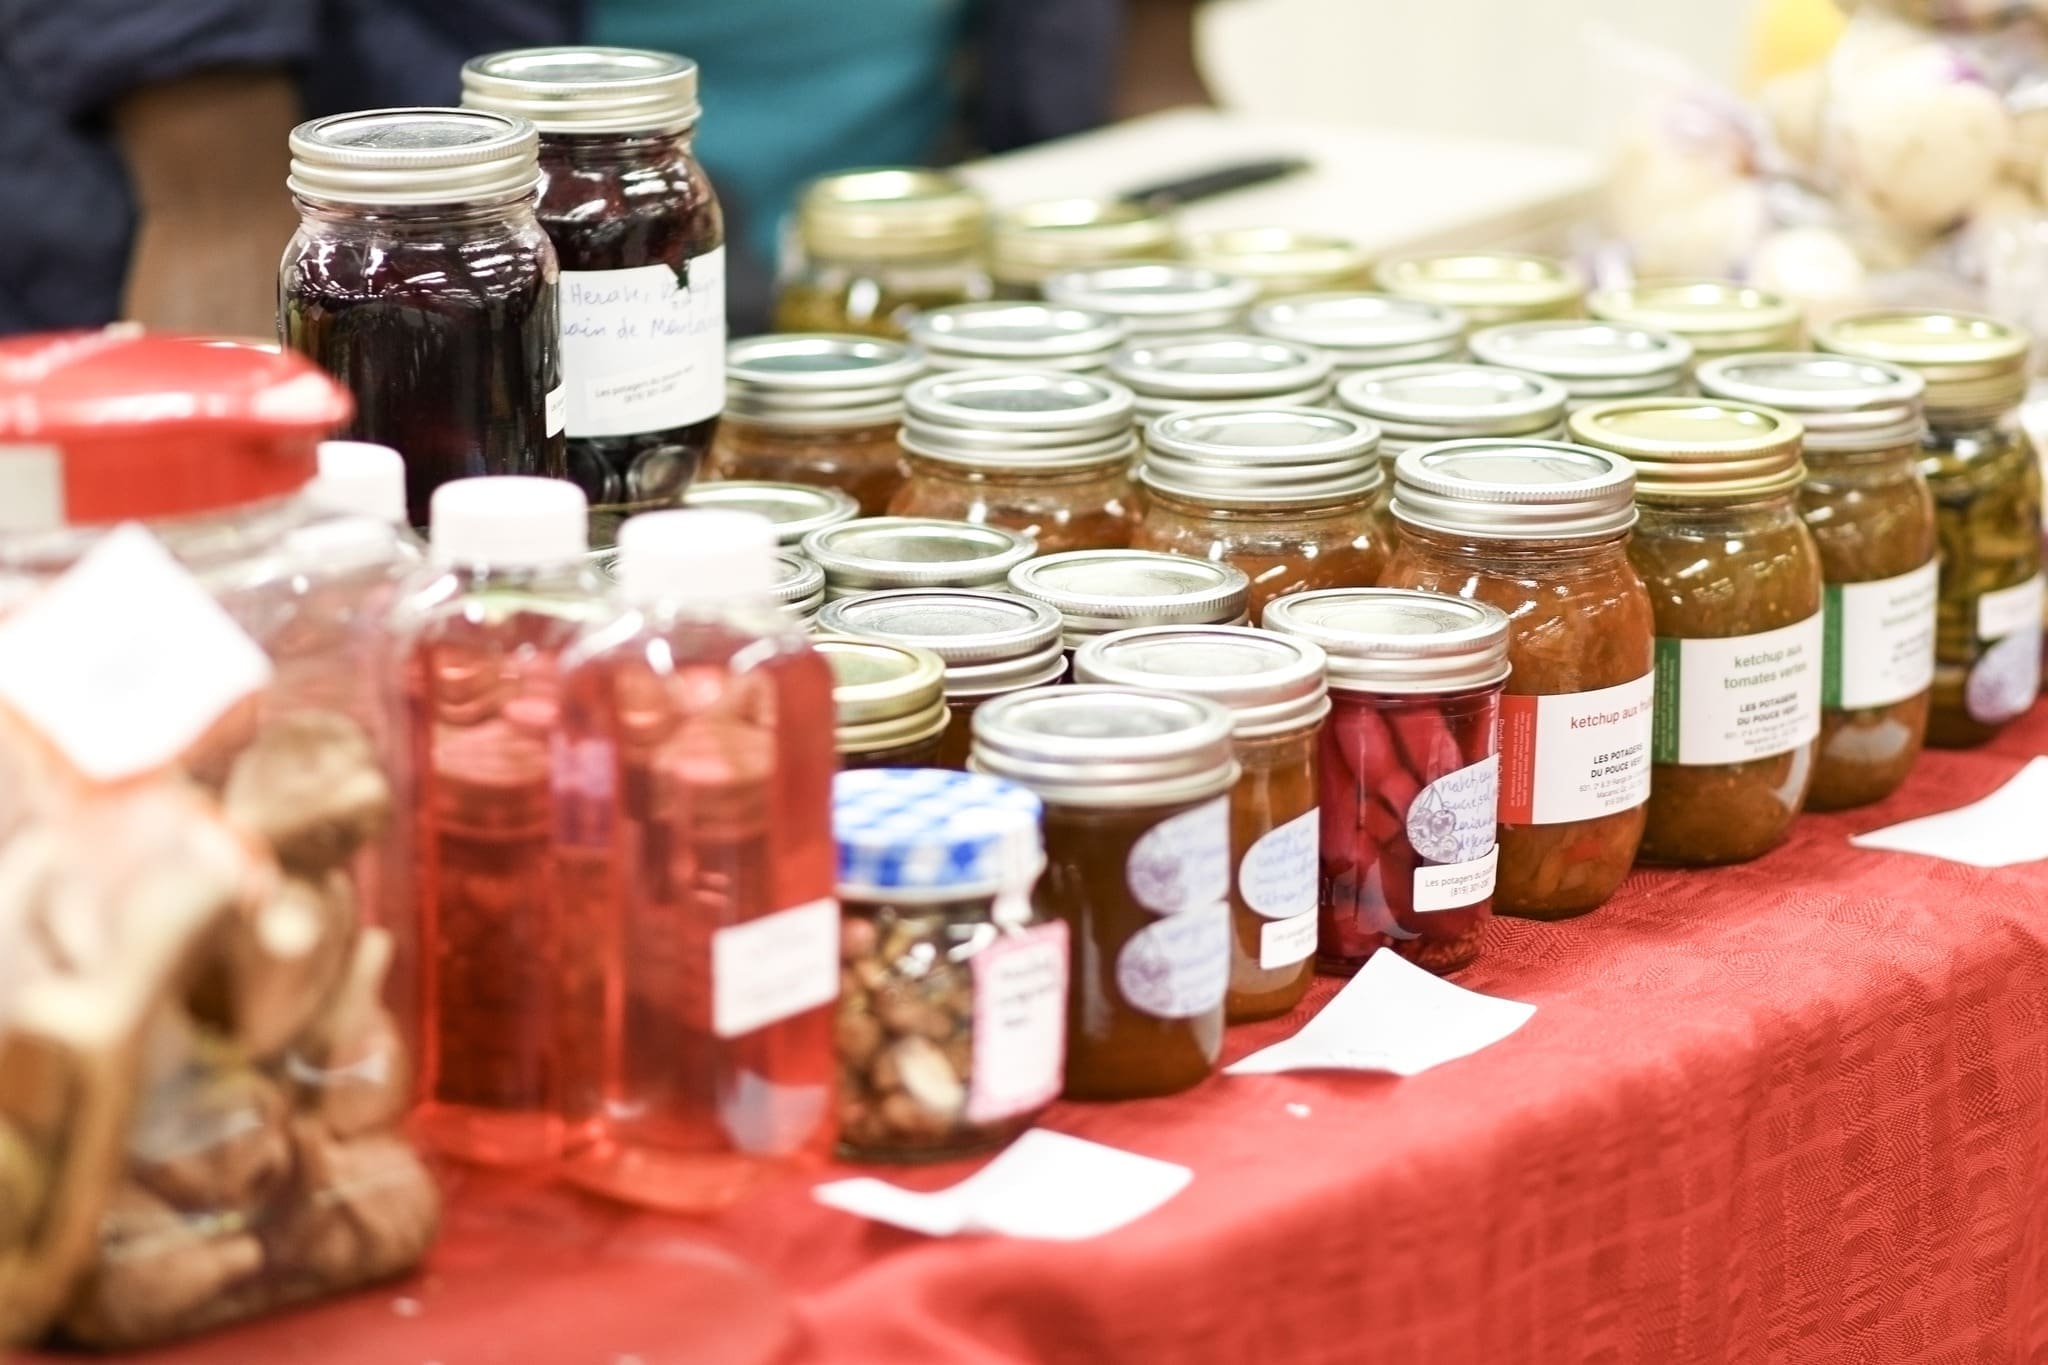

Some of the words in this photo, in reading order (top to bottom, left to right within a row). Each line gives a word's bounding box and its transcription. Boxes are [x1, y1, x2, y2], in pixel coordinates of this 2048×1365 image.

[617, 314, 639, 341] de
[1734, 649, 1783, 669] ketchup
[1724, 669, 1777, 690] tomates
[1739, 699, 1757, 714] LES
[1570, 710, 1619, 730] ketchup
[1622, 705, 1638, 720] aux
[1736, 714, 1750, 727] DU
[1753, 709, 1780, 724] POUCE
[1593, 751, 1609, 765] LES
[1591, 767, 1603, 778] DU
[1605, 760, 1629, 776] POUCE
[1424, 879, 1439, 889] Les
[1440, 873, 1474, 889] potagers
